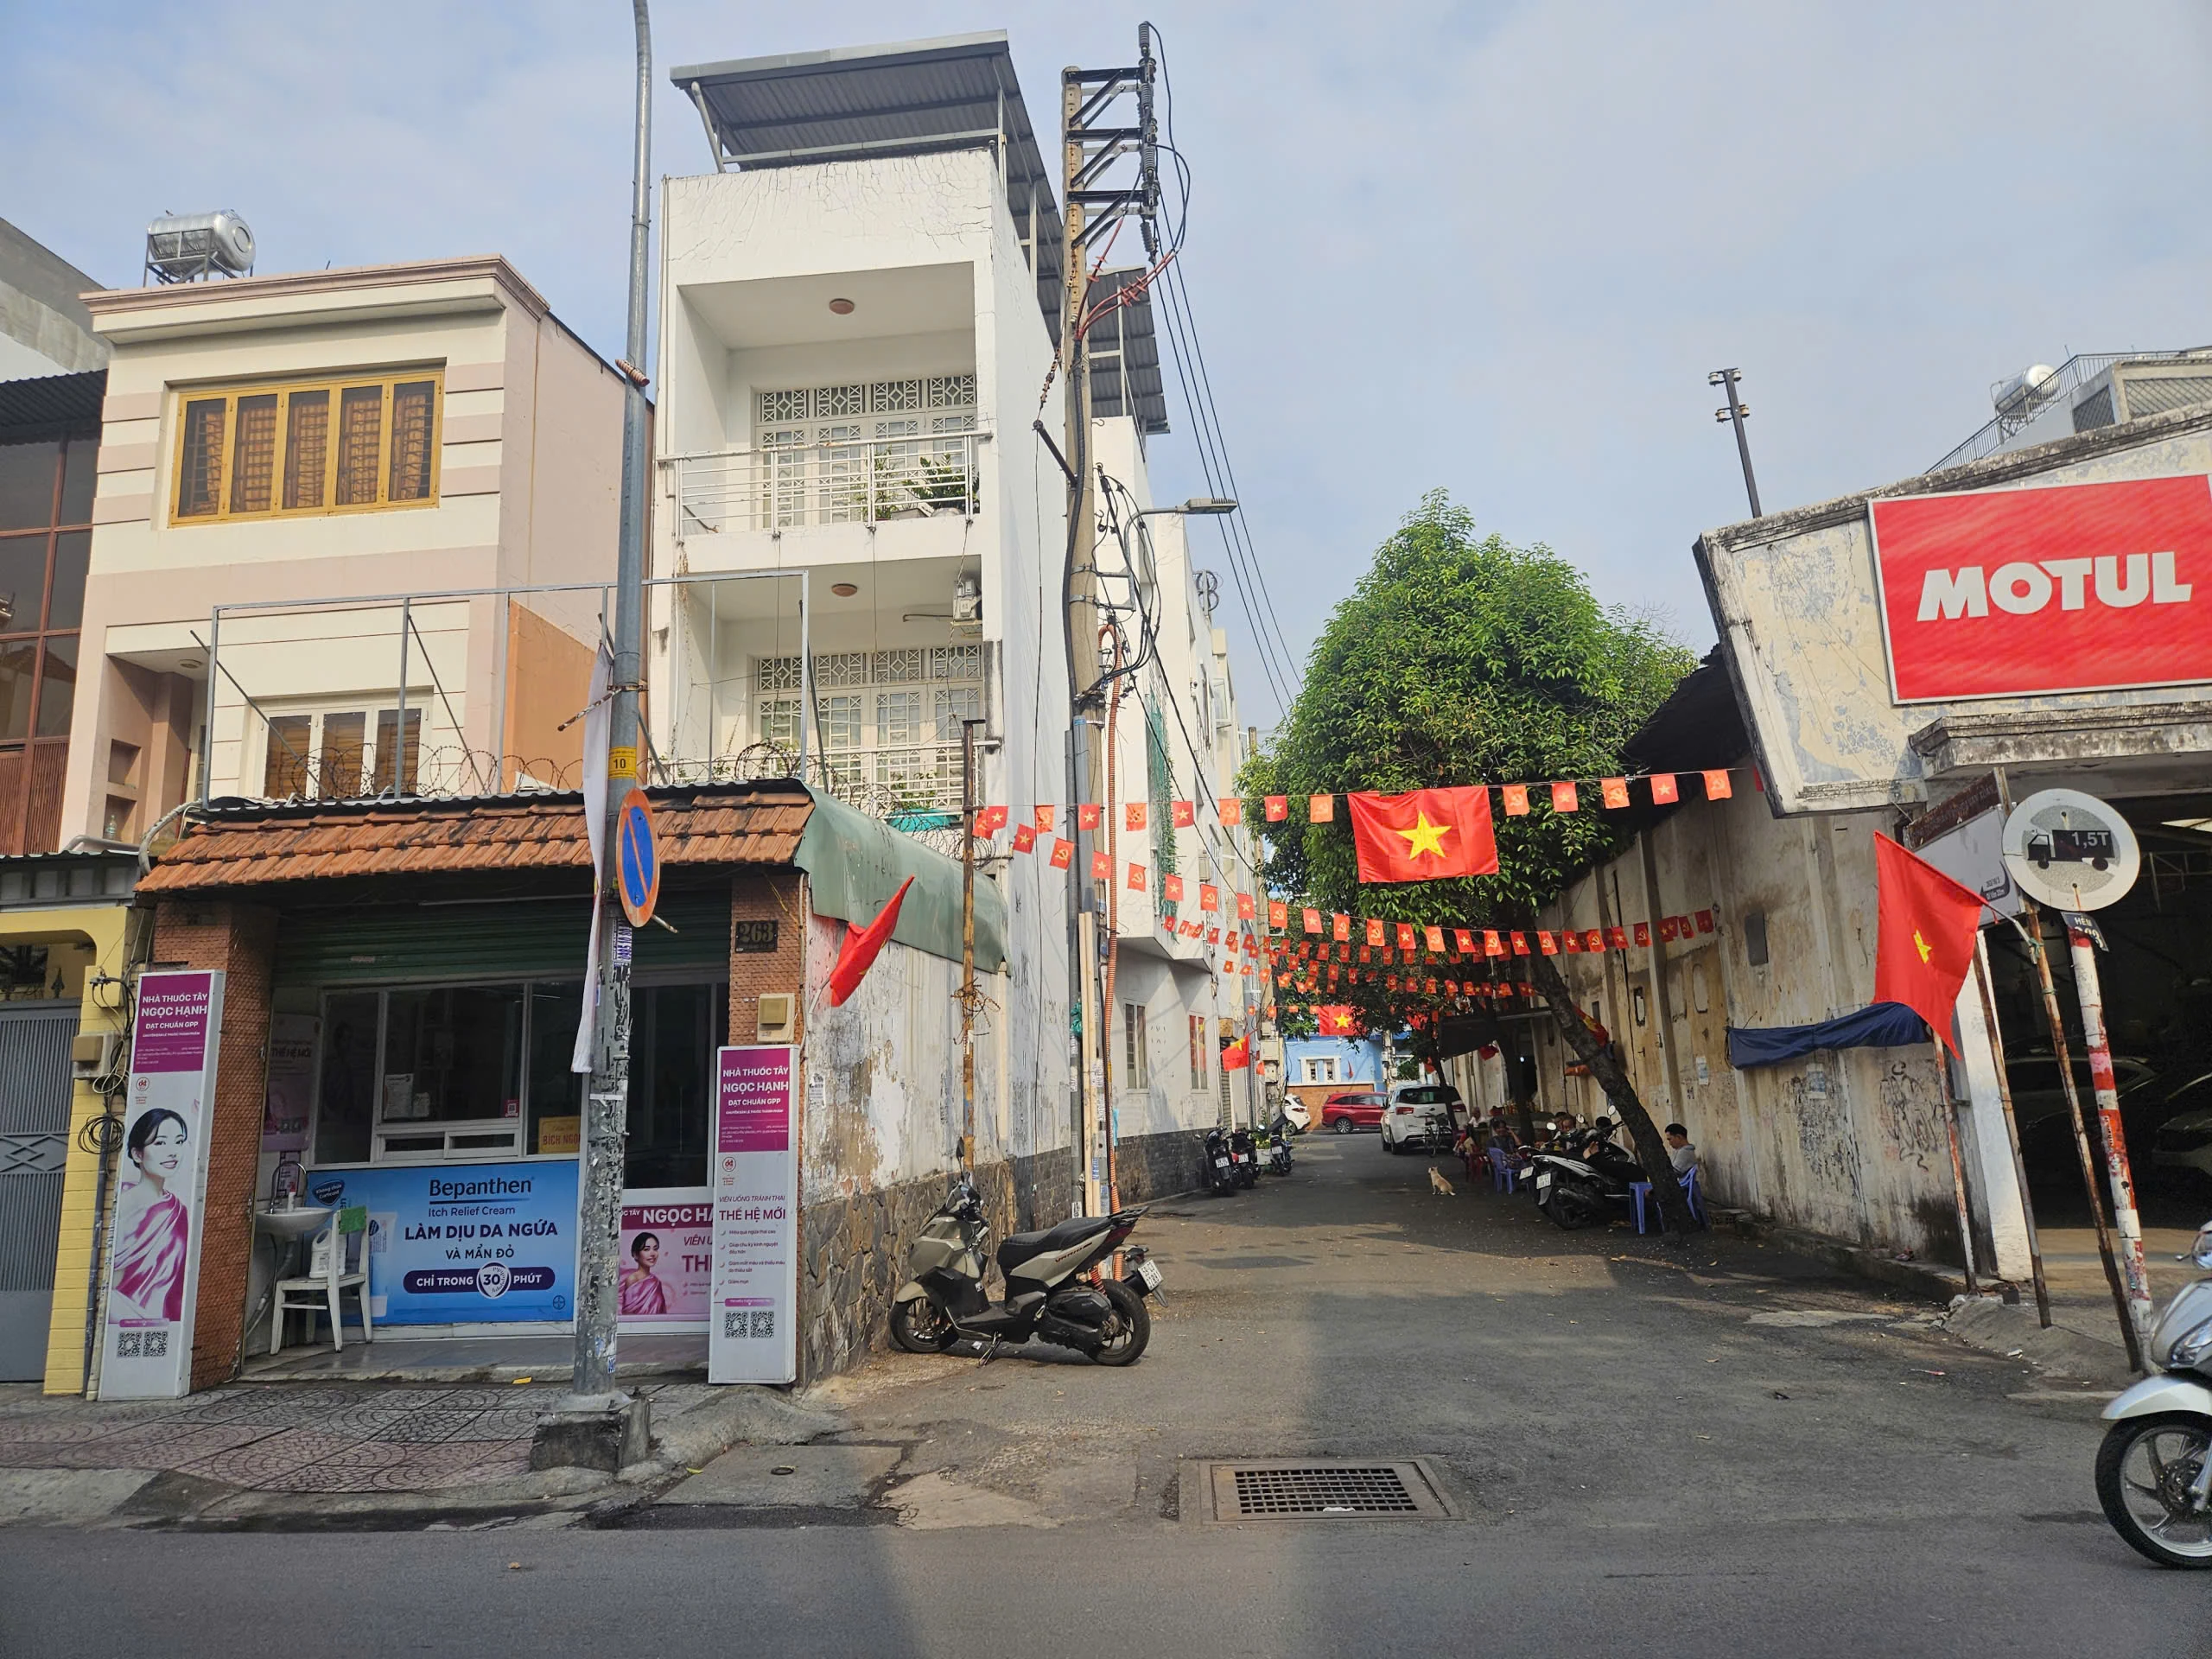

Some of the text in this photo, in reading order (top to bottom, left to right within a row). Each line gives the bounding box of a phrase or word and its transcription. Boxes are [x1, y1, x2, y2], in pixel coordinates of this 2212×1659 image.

[1916, 550, 2193, 622] MOTUL
[613, 758, 626, 769] 10
[2071, 831, 2109, 849] 1,5T
[739, 923, 774, 943] 263
[142, 992, 208, 1003] NHÀ THUỐC TÂY
[141, 1005, 208, 1019] NGỌC HẠNH
[722, 1065, 789, 1077] NHÀ THUỐC TÂY
[722, 1081, 789, 1095] NGỌC HẠNH
[728, 1098, 741, 1107] ĐẠT
[429, 1177, 531, 1199] Bepanthen
[429, 1205, 516, 1217] Itch Relief Cream
[642, 1208, 692, 1227] NGỌC
[719, 1206, 742, 1221] THẾ
[745, 1207, 760, 1223] HỆ
[764, 1206, 786, 1220] MỚI
[404, 1218, 558, 1243] LÀM DỊU DA NGỨA
[683, 1234, 706, 1246] VIÊN
[445, 1244, 515, 1260] VÀ MẨN ĐỎ
[682, 1255, 713, 1273] TH
[416, 1274, 543, 1287] CHỈ TRONG 30 PHÚT
